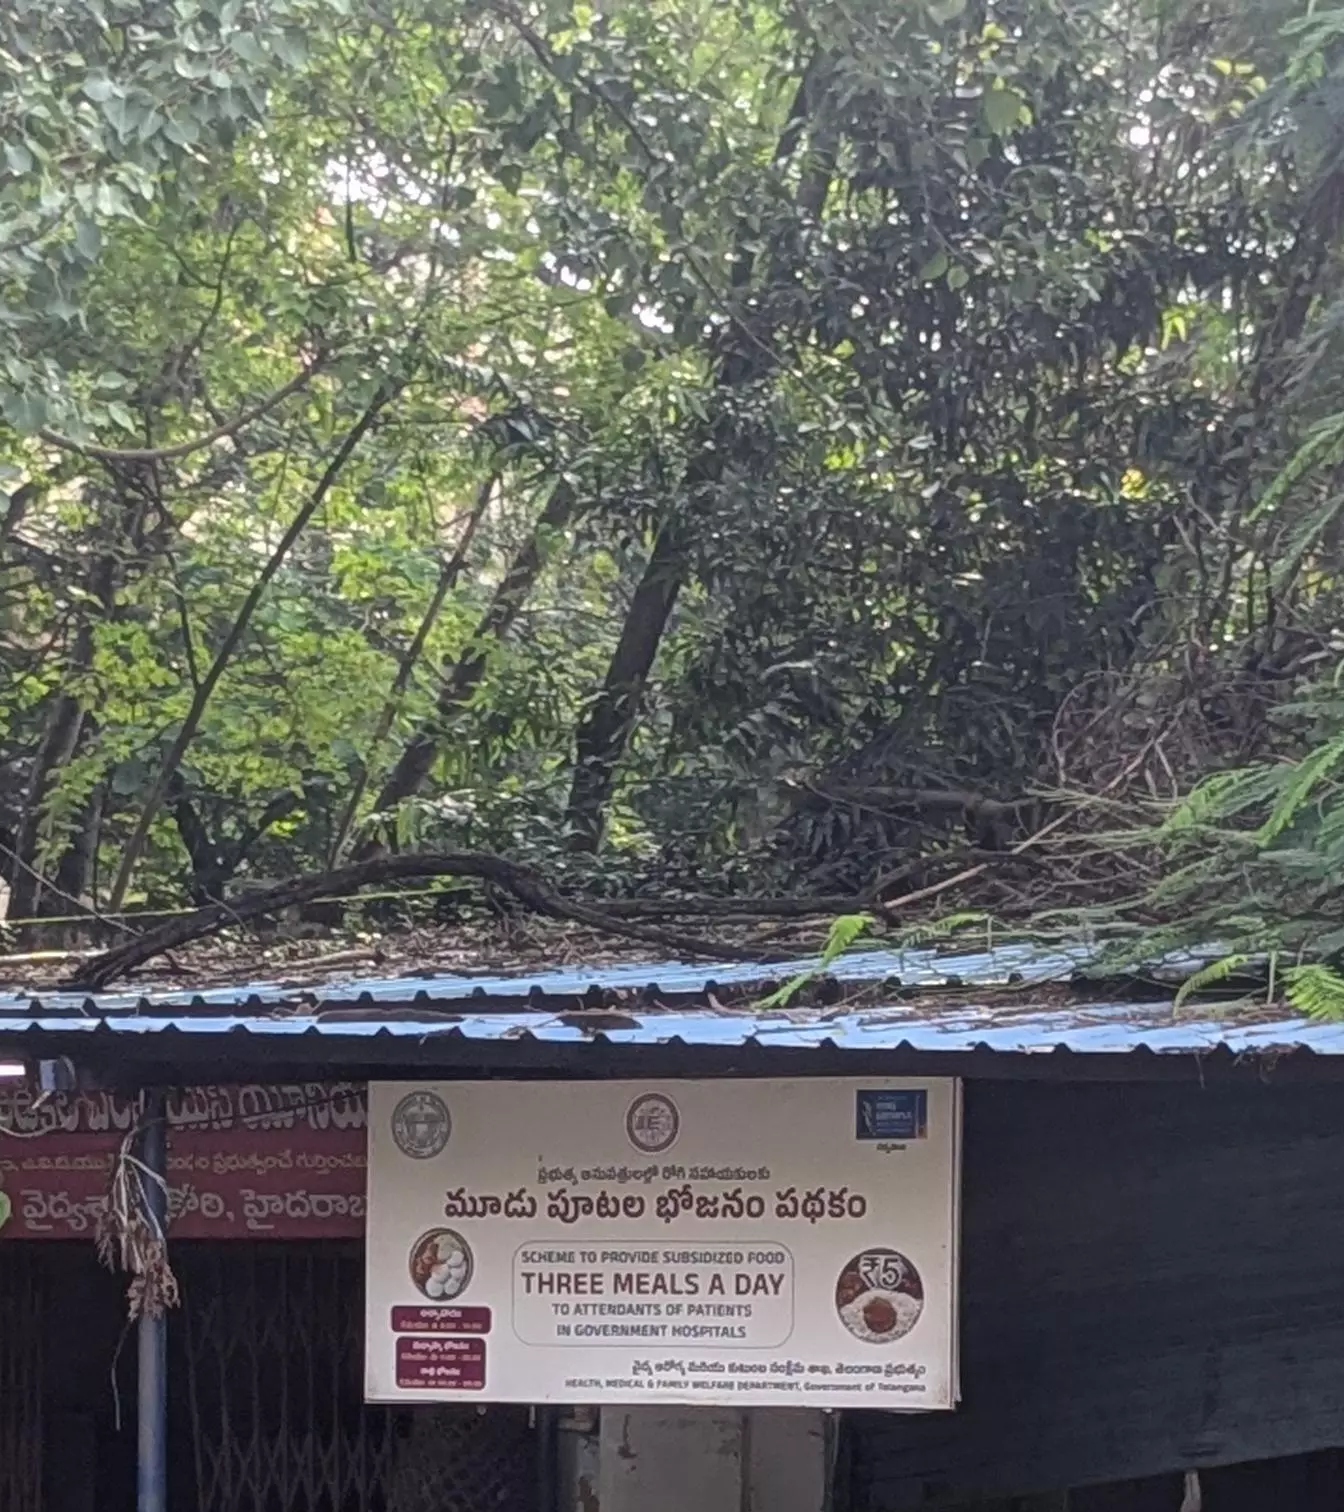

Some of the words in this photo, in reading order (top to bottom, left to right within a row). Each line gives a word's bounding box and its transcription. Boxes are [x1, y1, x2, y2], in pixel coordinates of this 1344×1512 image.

[538, 1167, 579, 1185] ప్రభుత్వ
[662, 1165, 686, 1180] రోగి
[444, 1187, 538, 1218] మూడు
[547, 1187, 646, 1224] పూటల
[655, 1184, 766, 1224] భోజనం
[775, 1187, 868, 1225] పథకం
[521, 1250, 576, 1264] SCHEME
[579, 1251, 597, 1264] TO
[601, 1250, 659, 1264] PROVIDE
[662, 1251, 744, 1265] SUBSIDIZED
[747, 1252, 786, 1265] FOOD
[521, 1271, 606, 1295] THREE
[612, 1272, 700, 1295] MEALS
[707, 1273, 726, 1296] A
[734, 1273, 786, 1297] DAY
[552, 1302, 570, 1316] TO
[572, 1302, 662, 1317] ATTENDANTS
[664, 1303, 685, 1317] OF
[686, 1303, 753, 1318] PATIENTS
[556, 1324, 572, 1337] IN
[574, 1324, 669, 1338] GOVERNMENT
[671, 1324, 747, 1339] HOSPITALS
[565, 1379, 604, 1390] HEALTH,
[606, 1379, 645, 1389] MEDICAL
[656, 1380, 689, 1389] FAMILY
[692, 1380, 735, 1390] WELFARE
[804, 1382, 862, 1392] Government
[864, 1383, 876, 1392] of
[878, 1383, 927, 1394] Telangana
